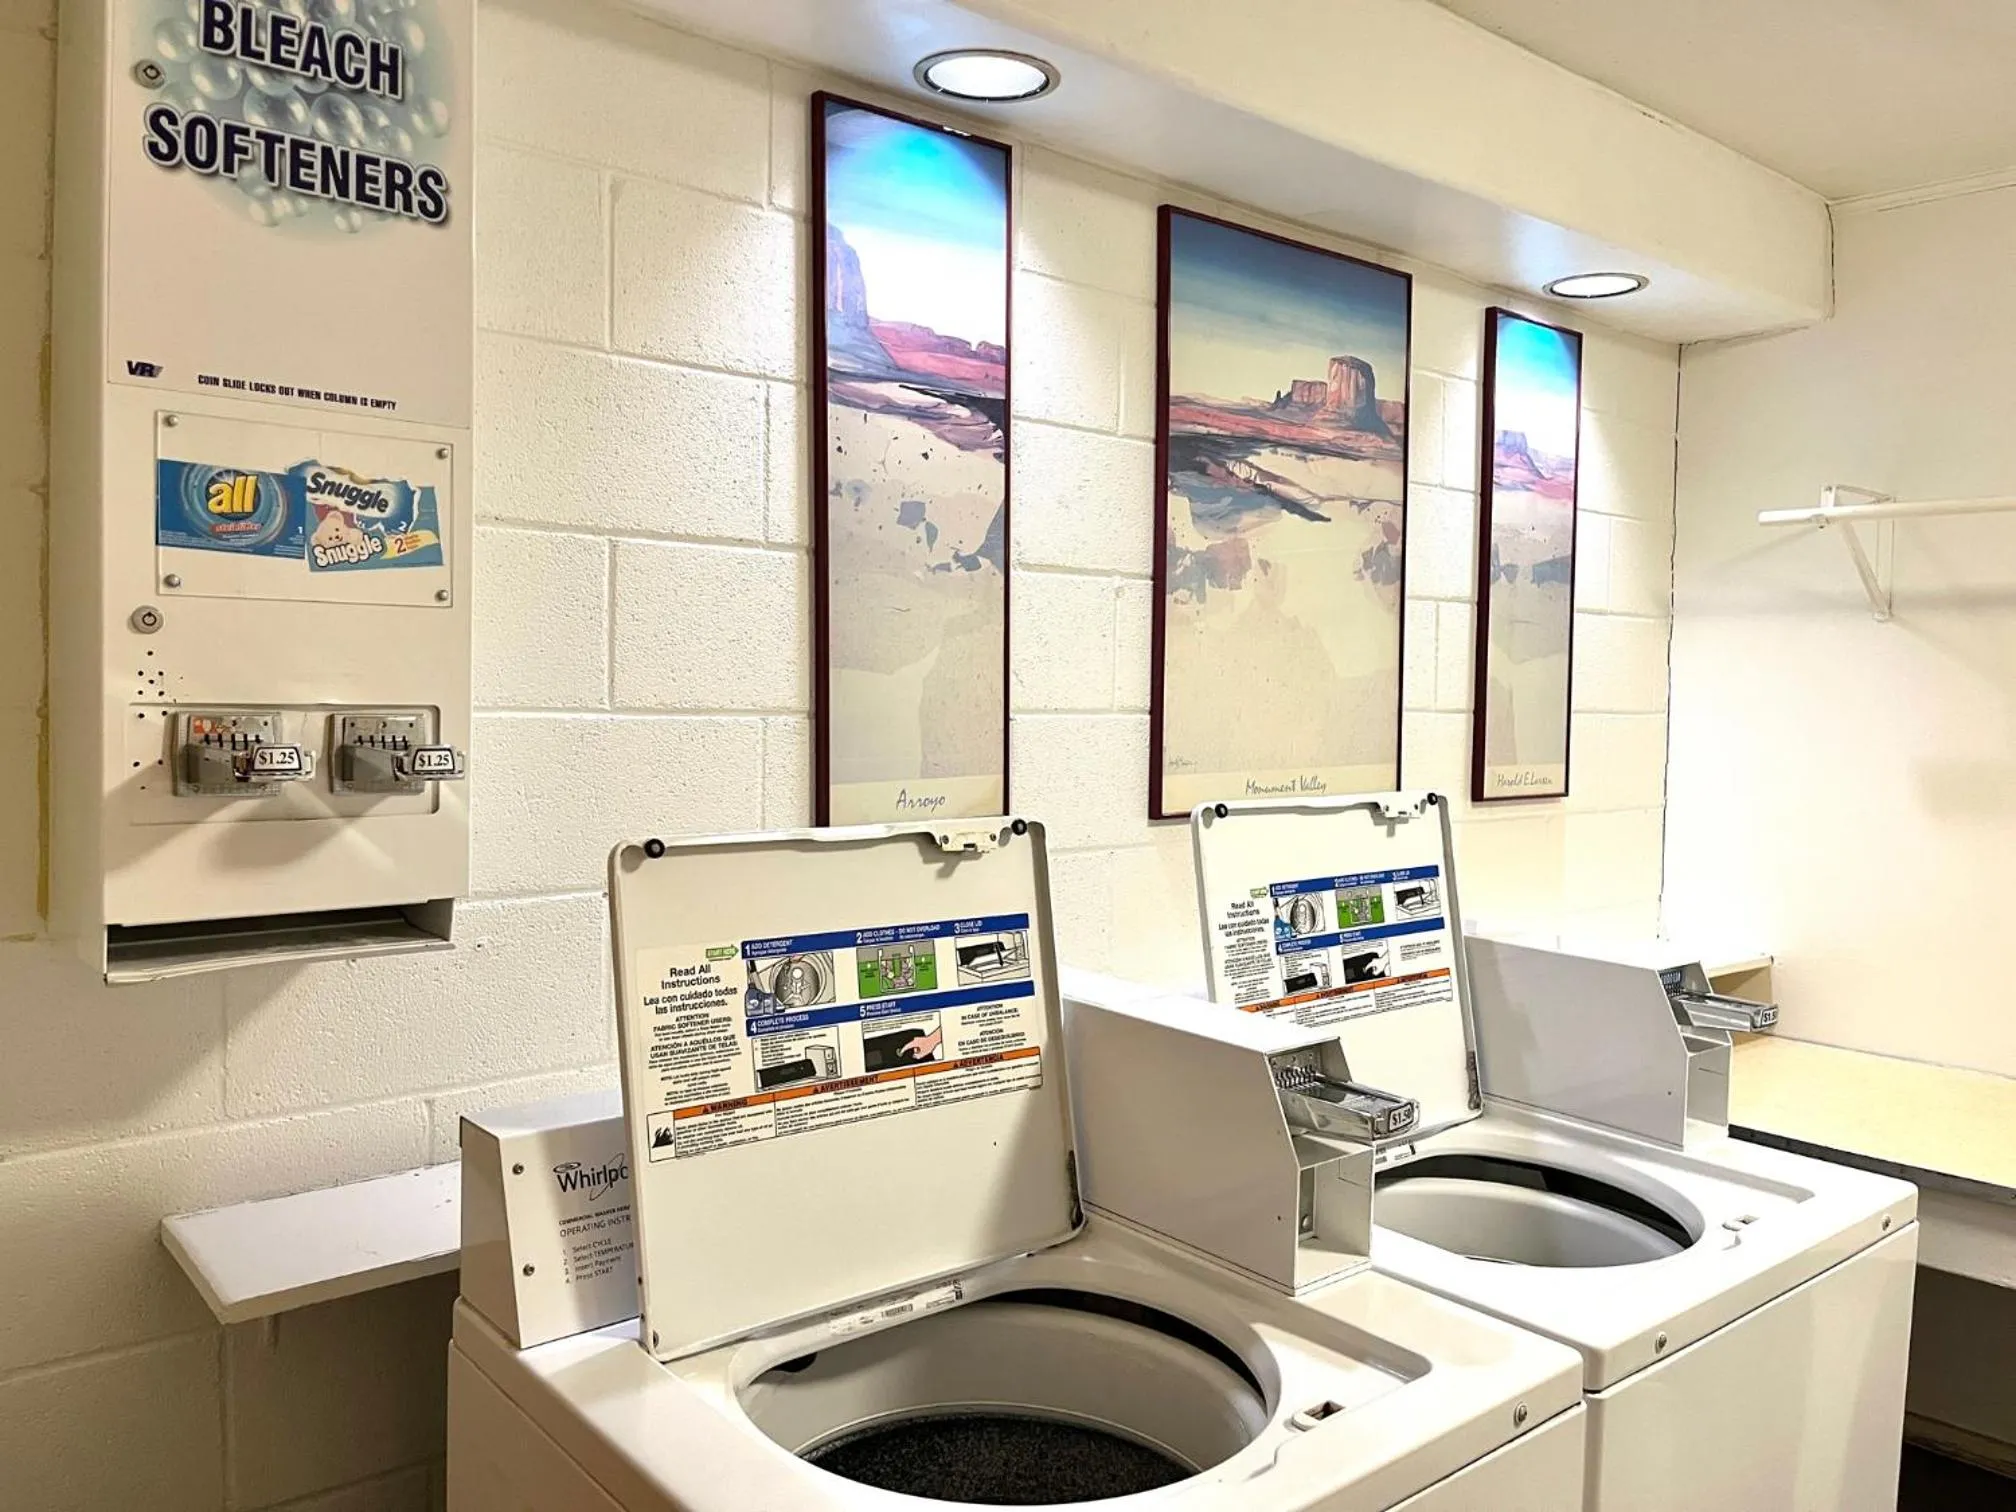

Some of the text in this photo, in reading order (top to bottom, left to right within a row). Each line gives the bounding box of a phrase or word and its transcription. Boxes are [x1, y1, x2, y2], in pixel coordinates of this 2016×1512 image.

[202, 0, 402, 98] BLEACH
[146, 108, 449, 222] SOFTENERS
[198, 374, 397, 411] COIN SLIDE LOCKS OUT WHEN COLUMN IS EMPTY
[207, 475, 258, 515] all
[307, 472, 389, 513] Snuggle
[398, 521, 408, 532] 2
[313, 534, 383, 568] Snuggle
[394, 538, 407, 554] 2
[258, 751, 295, 765] $1.25
[418, 753, 450, 767] $1.25
[1245, 775, 1328, 795] Monument Valley
[895, 788, 946, 813] Arroyo
[953, 923, 961, 934] 3
[856, 933, 863, 944] 2
[745, 943, 751, 956] 1
[763, 939, 793, 949] DETERGENT
[669, 964, 712, 978] Read All
[661, 974, 721, 990] Instructions
[643, 986, 738, 1006] Lea con cuidado todas
[655, 998, 728, 1015] las instrucciones.
[859, 1006, 867, 1017] 5
[1763, 1011, 1777, 1023] $1.5
[653, 1023, 677, 1033] FABRIC
[750, 1022, 757, 1034] 4
[560, 1214, 631, 1237] OPERATING INSTR
[594, 1242, 634, 1257] TEMPERATUR
